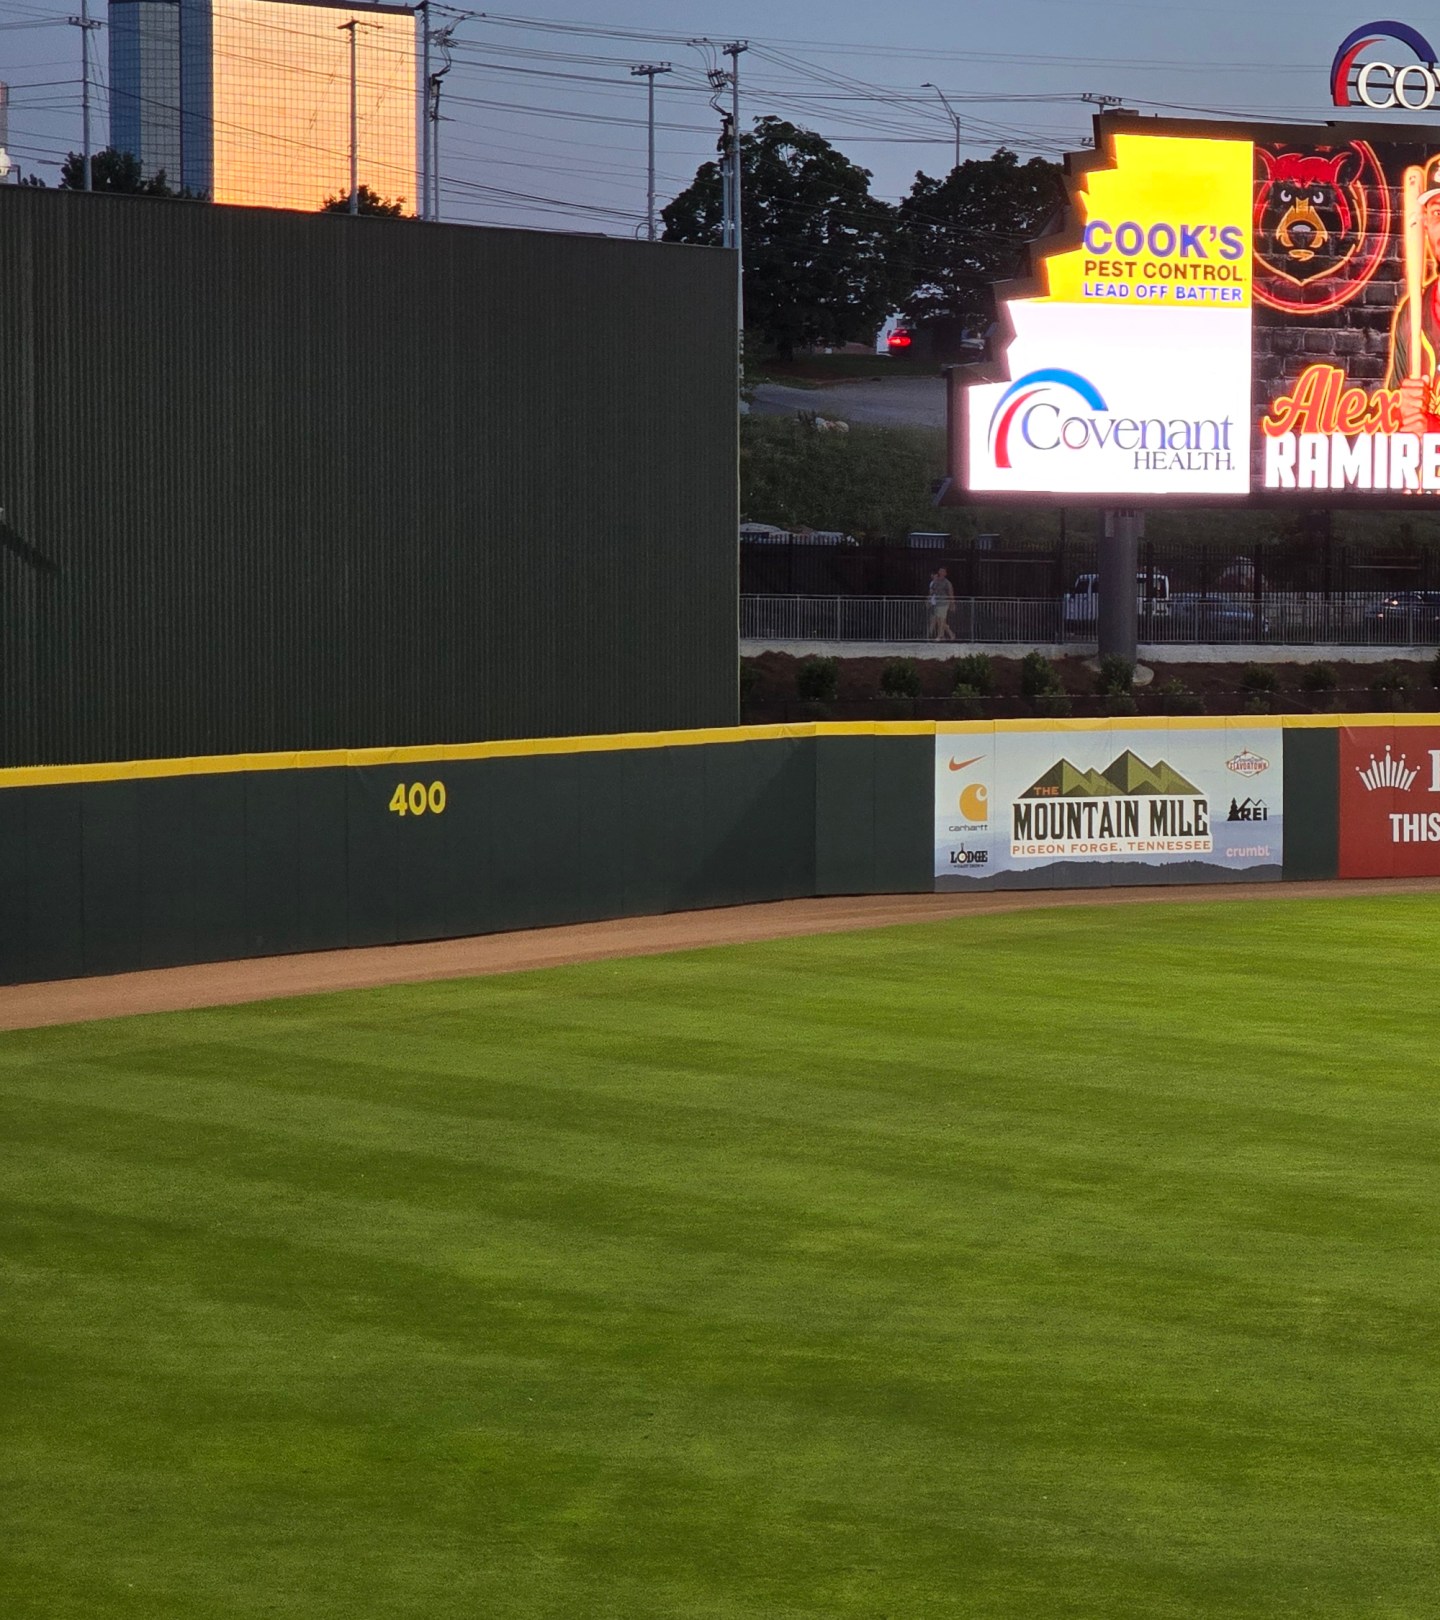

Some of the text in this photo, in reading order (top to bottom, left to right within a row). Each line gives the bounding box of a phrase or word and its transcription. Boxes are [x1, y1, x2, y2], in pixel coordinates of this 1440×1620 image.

[1084, 220, 1244, 260] COOK'S
[1085, 260, 1137, 278] PEST
[1084, 283, 1242, 301] LEAD OFF BATTER
[1263, 364, 1401, 437] Alex
[1022, 403, 1234, 450] Covenant
[389, 781, 446, 816] 400
[1034, 786, 1059, 796] THE
[1012, 798, 1209, 841] MOUNTAIN MILE
[1241, 807, 1267, 821] REI
[949, 823, 988, 832] carhartt
[950, 850, 988, 863] LODGE
[1012, 840, 1211, 855] PIGEON FORGE, TENNESSEE
[1226, 845, 1270, 857] crumbl
